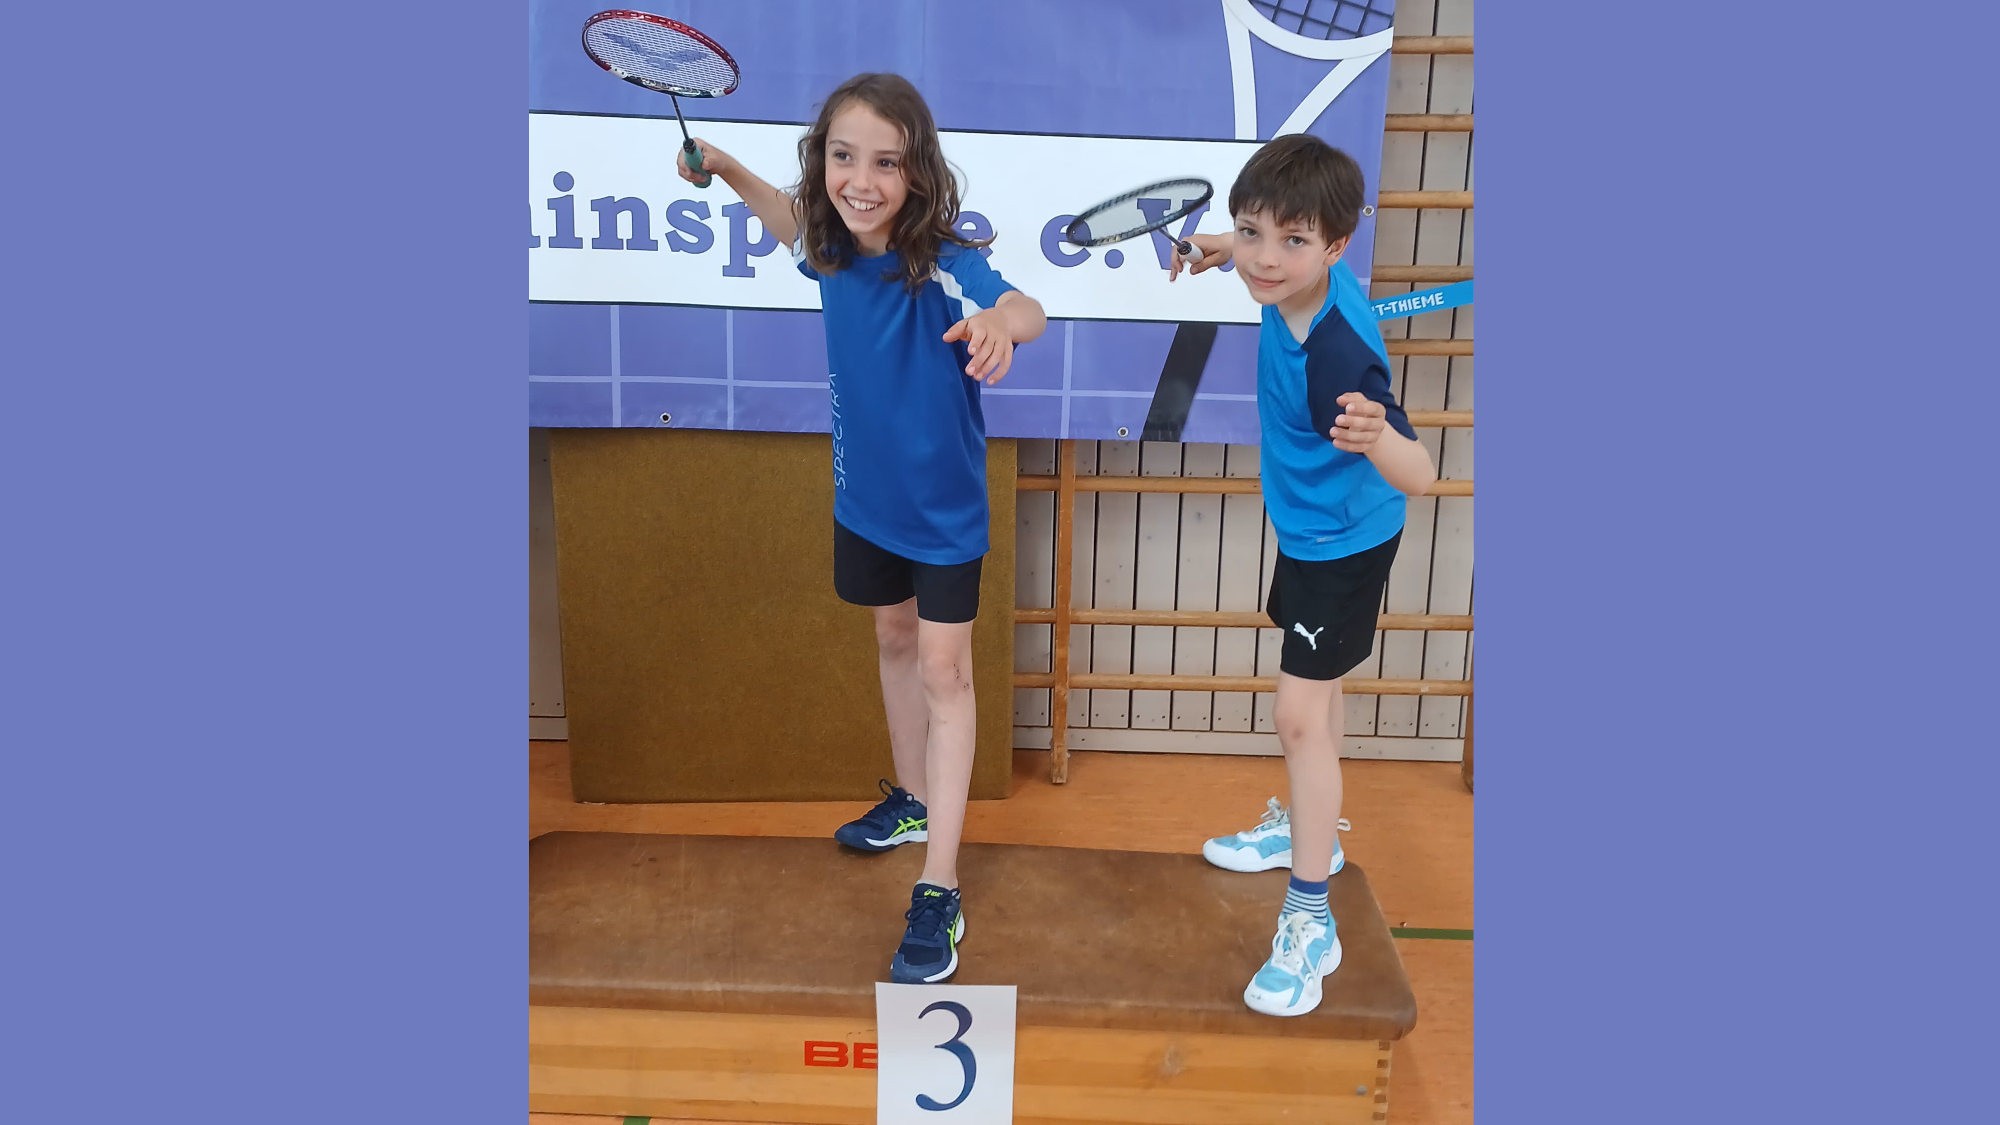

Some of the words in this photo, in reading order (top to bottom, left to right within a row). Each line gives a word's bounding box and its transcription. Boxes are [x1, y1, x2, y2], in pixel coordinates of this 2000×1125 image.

[1371, 292, 1445, 316] T-THIEME
[804, 1040, 878, 1069] BE
[915, 1000, 977, 1112] 3
